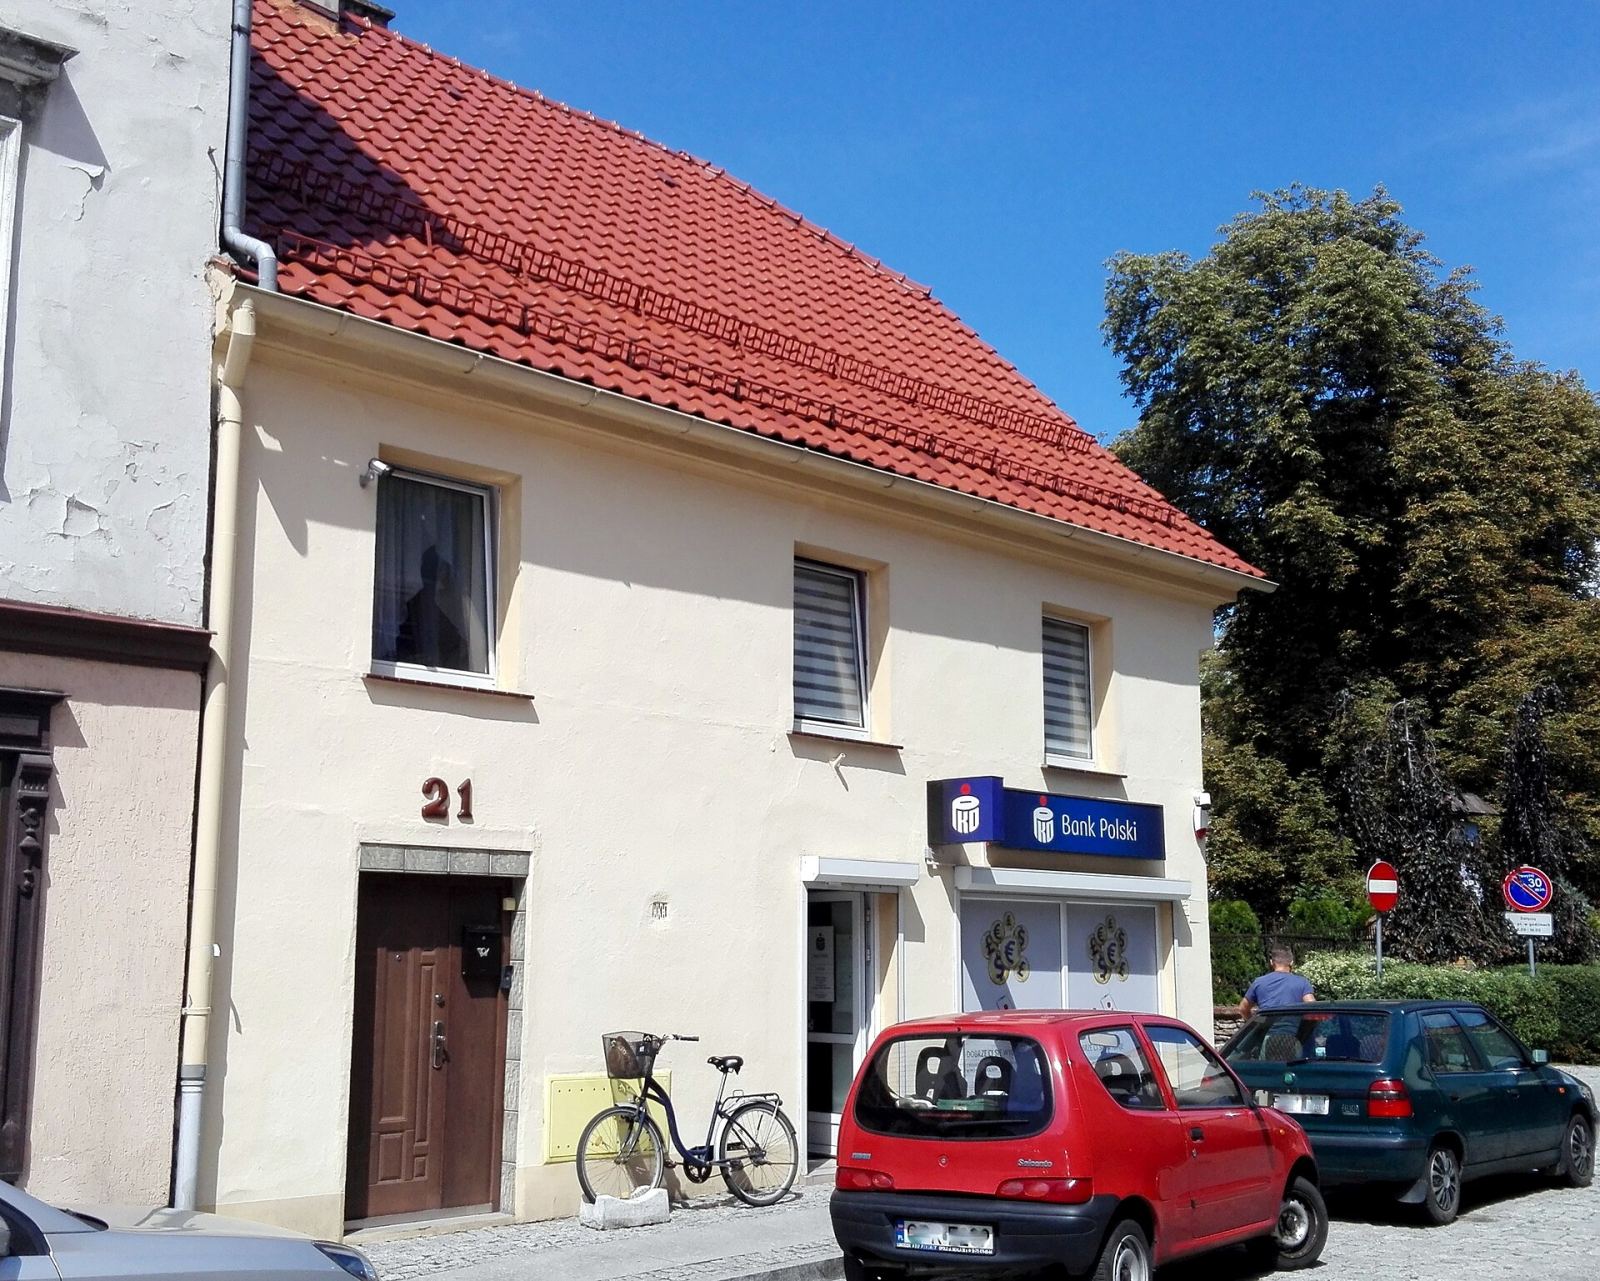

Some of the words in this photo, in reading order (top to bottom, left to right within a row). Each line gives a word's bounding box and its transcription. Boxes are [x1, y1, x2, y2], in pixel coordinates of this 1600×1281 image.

[421, 777, 474, 826] 21
[1061, 814, 1096, 838] Bank
[1100, 818, 1137, 842] Polski
[1528, 878, 1543, 888] 30
